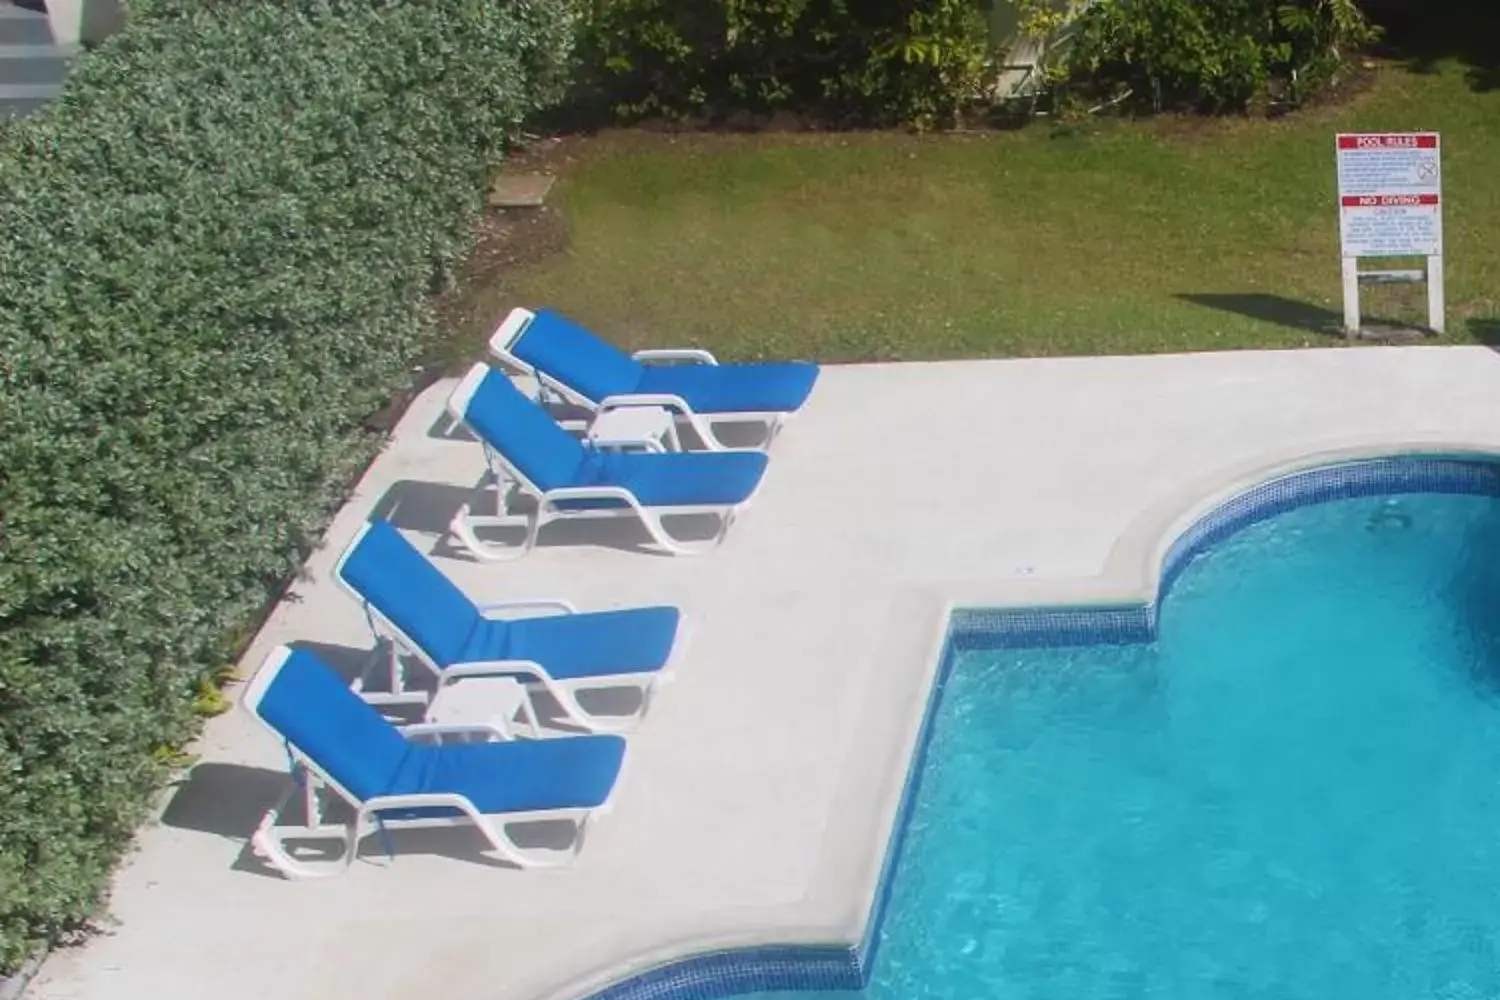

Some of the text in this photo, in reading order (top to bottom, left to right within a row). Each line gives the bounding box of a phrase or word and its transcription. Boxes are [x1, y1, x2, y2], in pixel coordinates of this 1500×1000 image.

[1357, 136, 1418, 148] POOL RULES
[1360, 195, 1420, 205] NO DIVING
